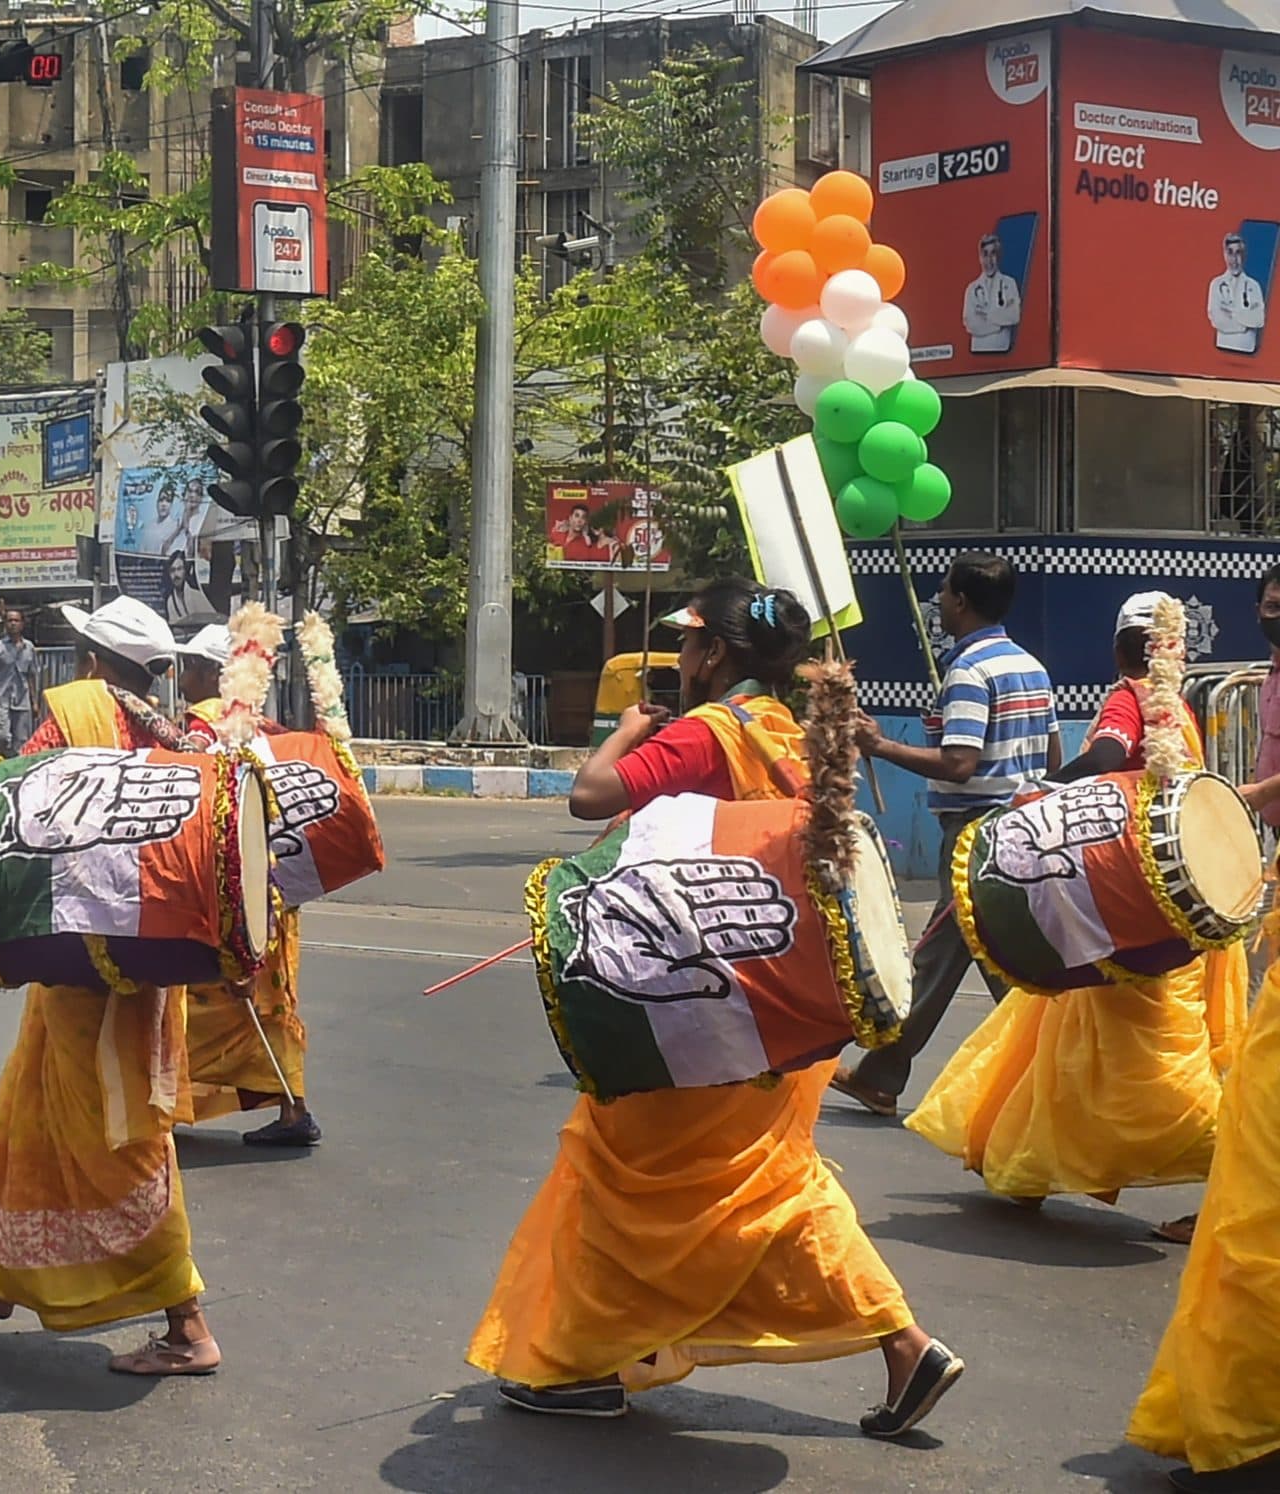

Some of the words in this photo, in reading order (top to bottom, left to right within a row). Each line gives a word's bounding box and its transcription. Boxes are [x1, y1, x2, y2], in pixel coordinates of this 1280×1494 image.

[992, 43, 1031, 66] Apollo
[31, 55, 58, 79] 00
[1228, 64, 1277, 92] Apollo
[243, 101, 283, 116] Consult
[243, 117, 276, 132] Apollo
[278, 121, 312, 135] Doctor
[1079, 110, 1115, 126] Doctor
[1119, 115, 1193, 136] Consultations
[243, 133, 254, 145] in
[256, 134, 268, 146] 15
[1074, 134, 1145, 169] Direct
[882, 165, 923, 183] Starting
[925, 162, 937, 178] @
[1075, 168, 1149, 204] Apollo
[1153, 177, 1219, 210] theke
[263, 224, 294, 241] Apollo
